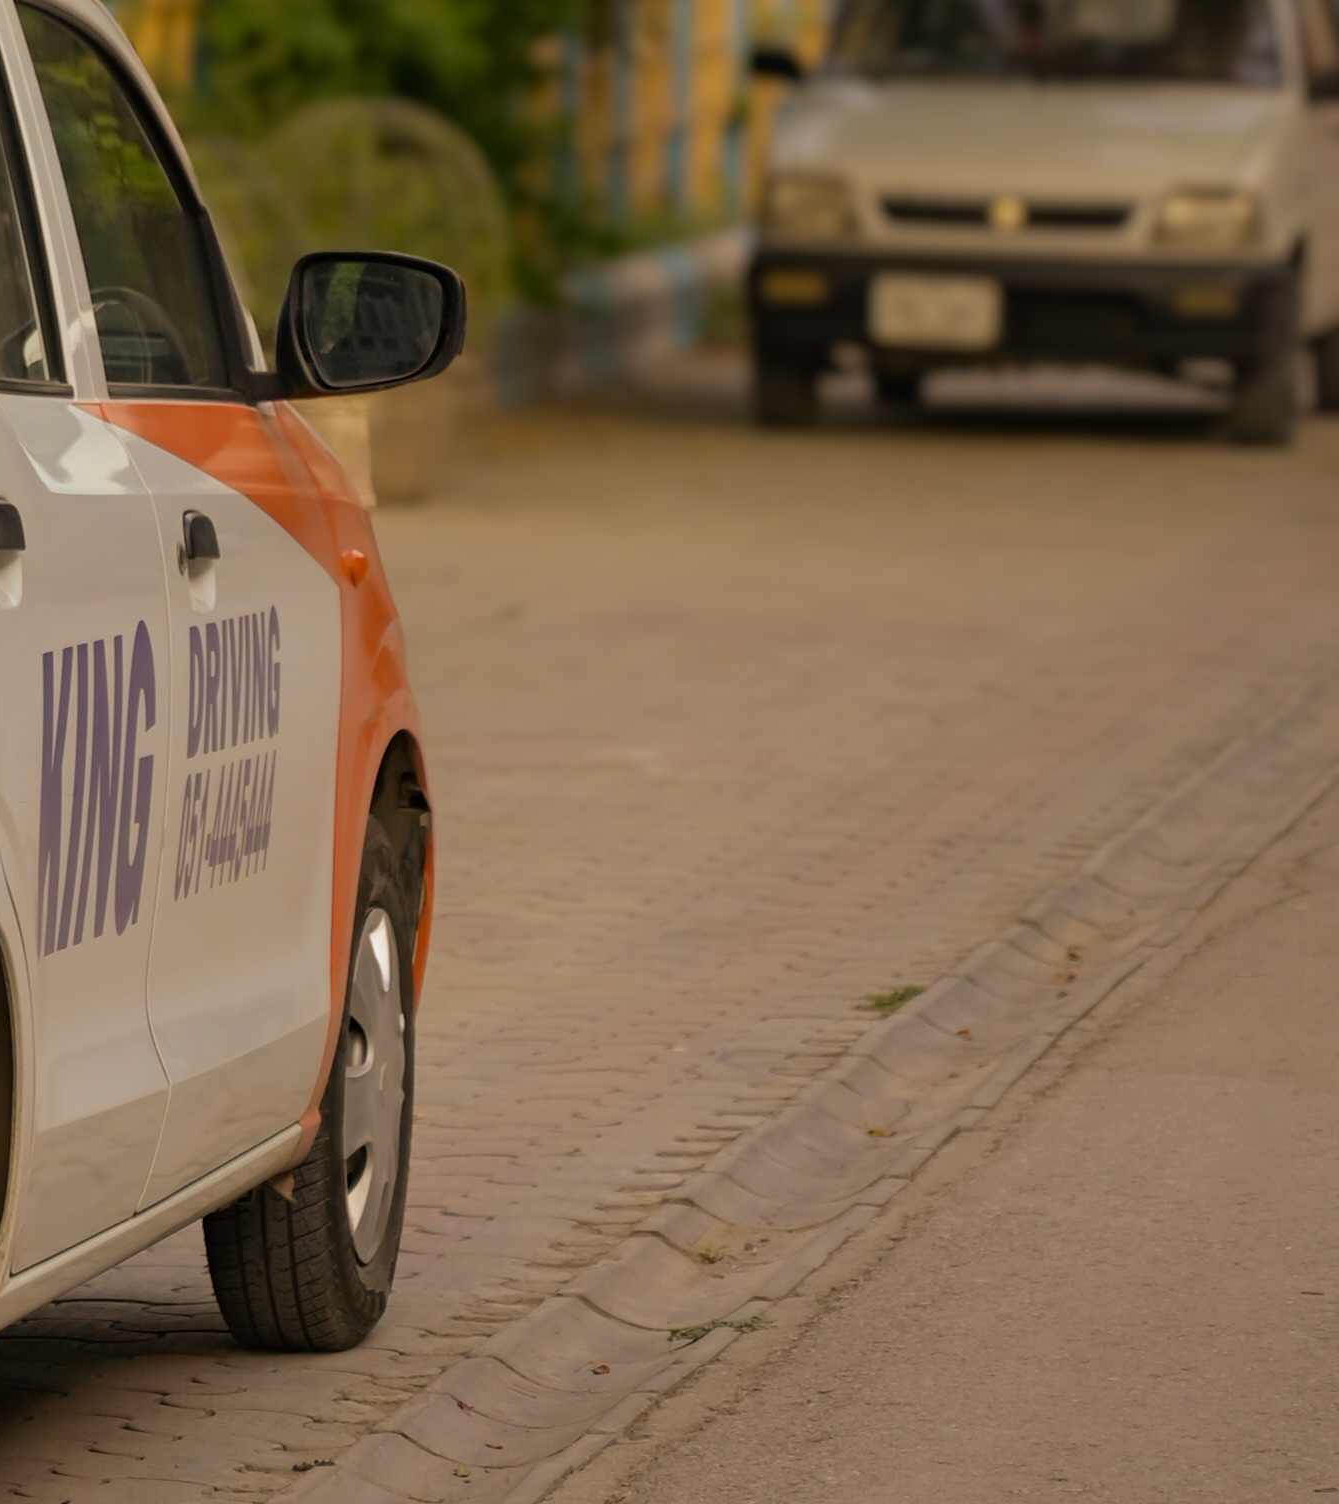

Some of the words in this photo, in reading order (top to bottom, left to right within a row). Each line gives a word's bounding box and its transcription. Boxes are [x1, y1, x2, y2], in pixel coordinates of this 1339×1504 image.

[187, 605, 281, 759] DRIVING
[38, 619, 156, 957] KING
[174, 749, 277, 901] 051-4445444
